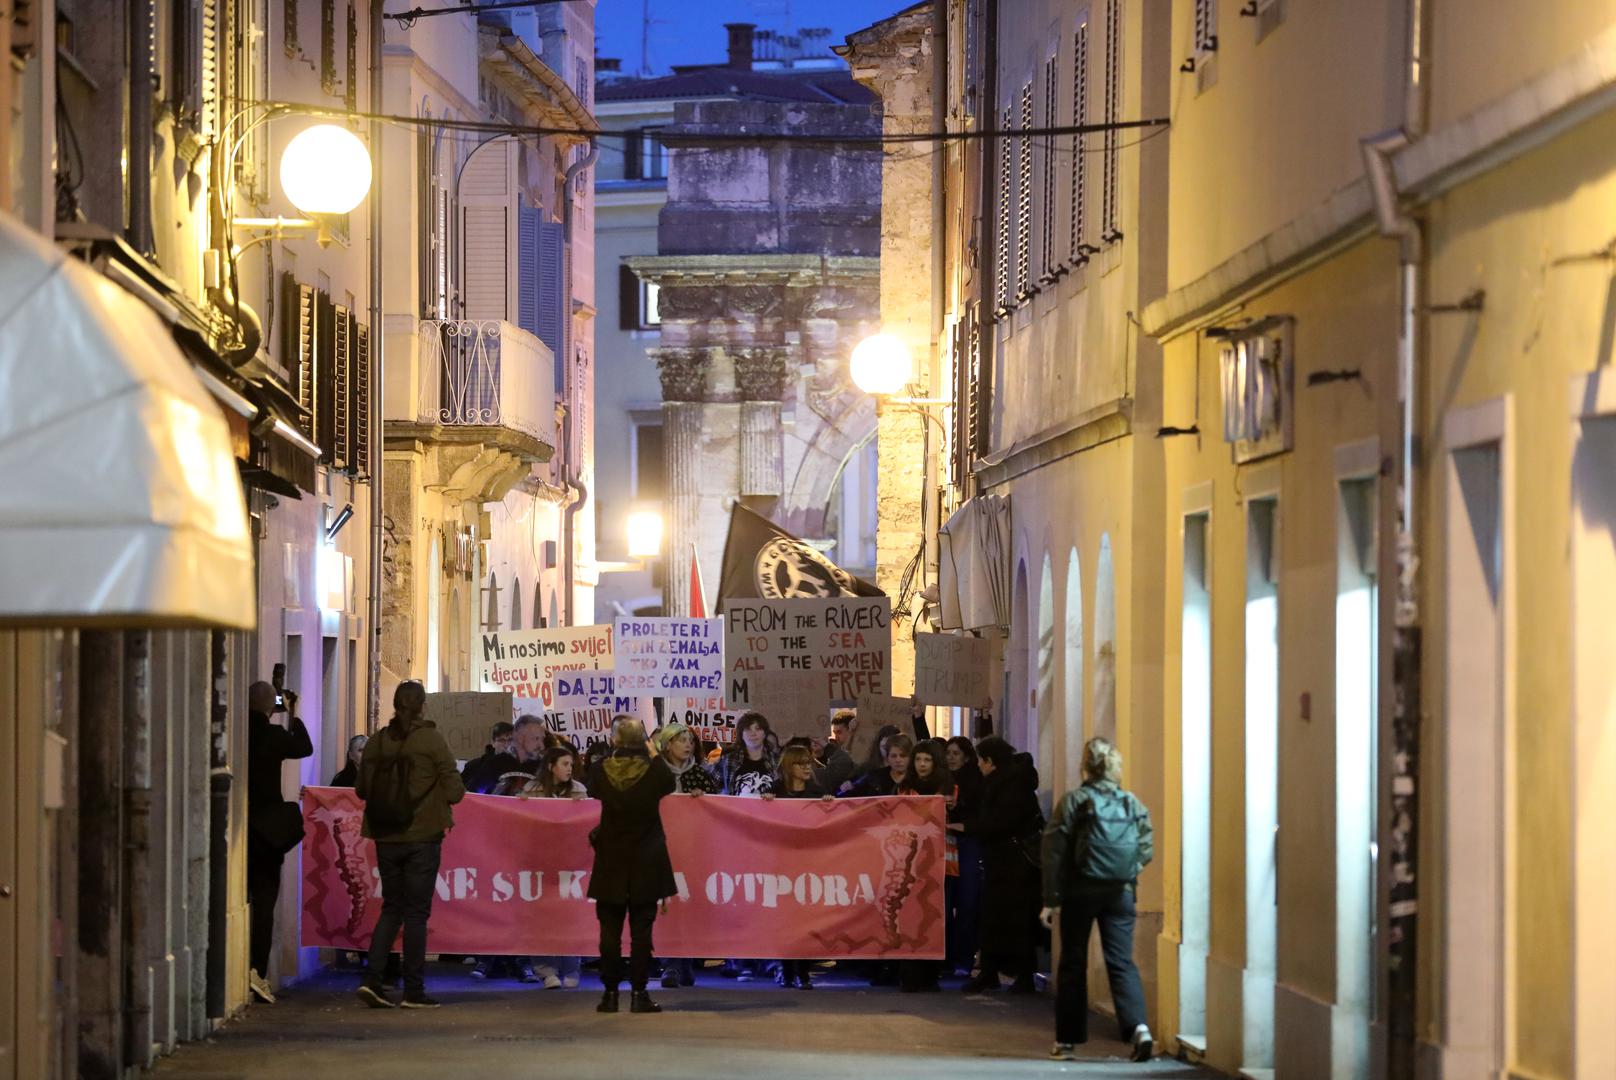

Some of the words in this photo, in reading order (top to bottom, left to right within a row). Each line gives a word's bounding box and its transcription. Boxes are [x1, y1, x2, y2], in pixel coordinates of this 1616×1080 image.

[730, 605, 786, 633] FROM
[795, 615, 818, 628] THE
[825, 604, 886, 629] RIVER
[621, 620, 709, 638] PROLETERI
[482, 633, 505, 662] Mi
[509, 639, 566, 658] nosimo
[570, 626, 613, 658] svijet
[746, 636, 768, 652] TO
[780, 636, 806, 649] THE
[829, 632, 865, 648] SEA
[668, 658, 700, 670] VAM
[733, 656, 765, 672] ALL
[778, 655, 812, 670] THE
[820, 651, 884, 671] WOMEN
[484, 669, 489, 683] i
[491, 662, 528, 685] djecu
[533, 664, 538, 679] i
[661, 670, 722, 690] ČARAPE?
[590, 677, 615, 694] LJU
[686, 695, 738, 712] DIJEL
[544, 713, 566, 732] NE
[669, 711, 679, 723] A
[685, 710, 708, 727] ONI
[712, 712, 736, 728] SE
[492, 870, 543, 903] SU
[705, 871, 875, 908] OTPORA
